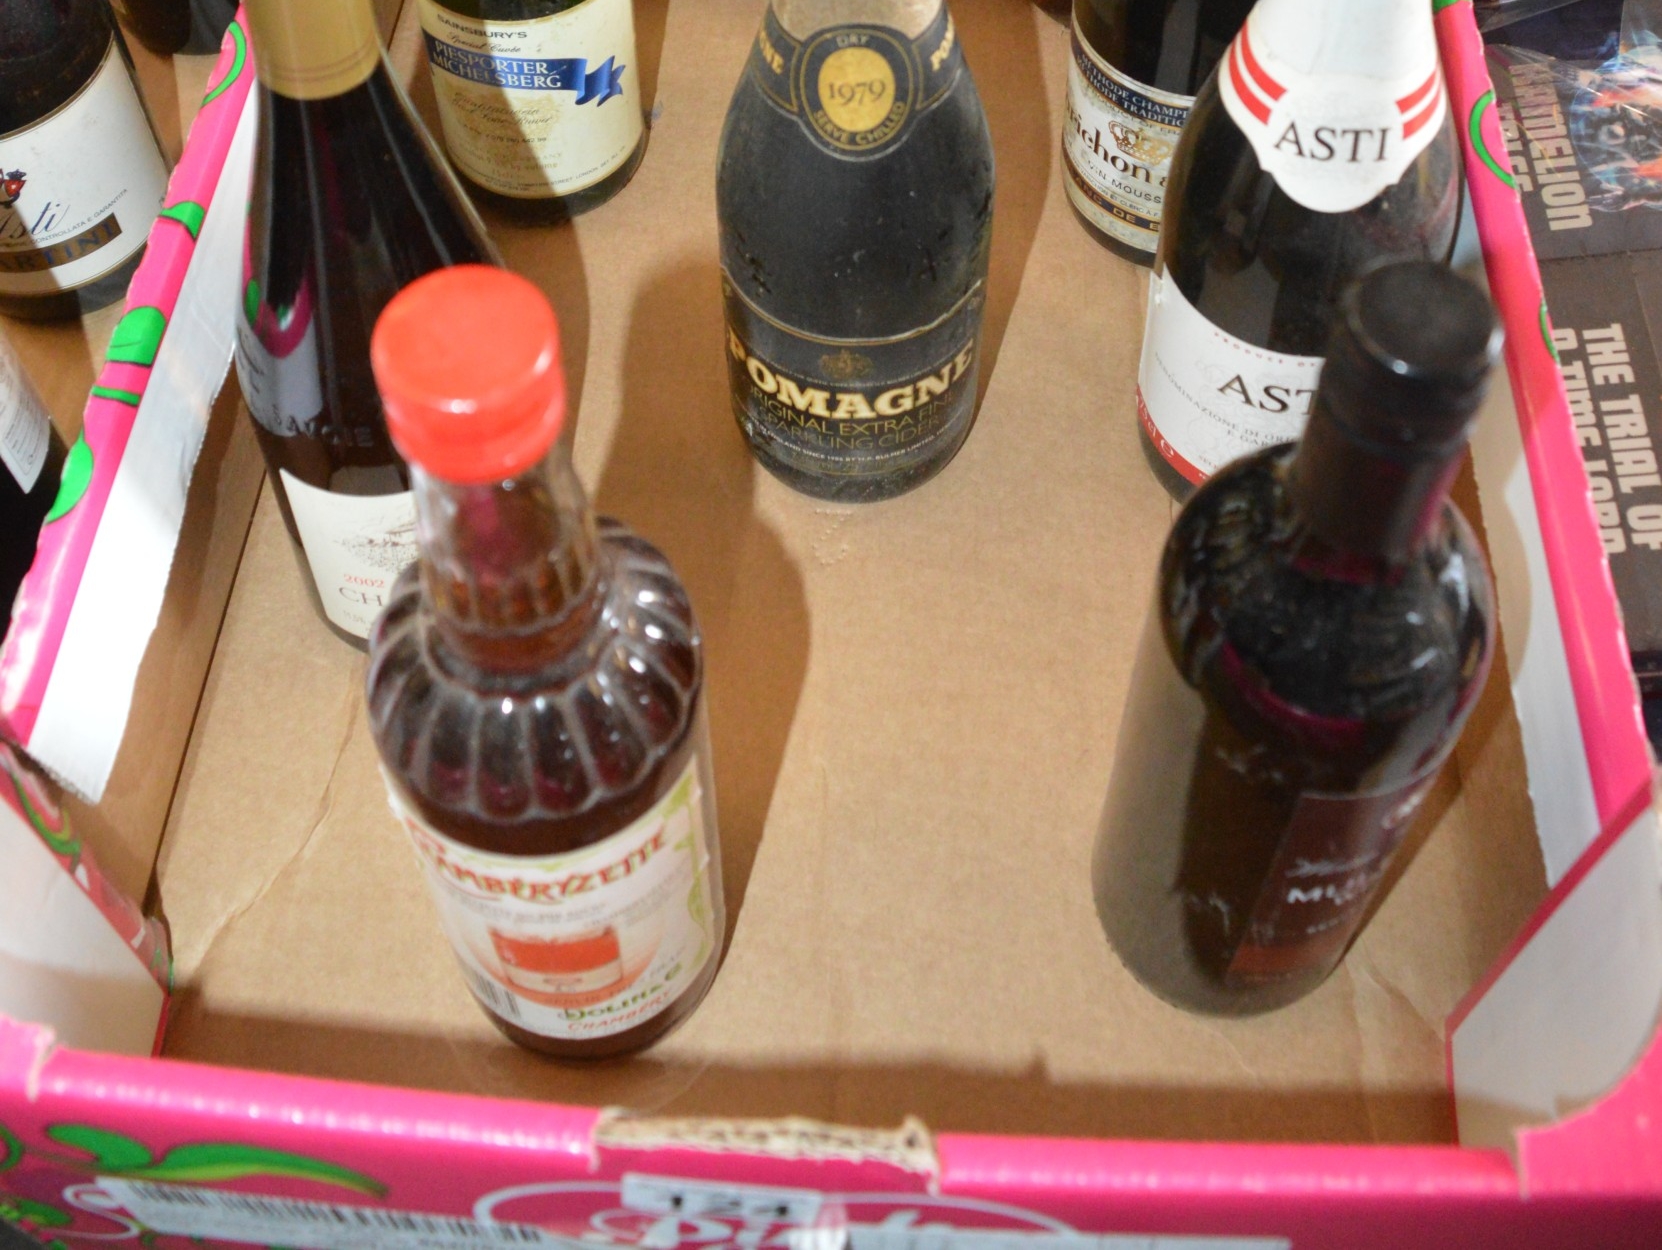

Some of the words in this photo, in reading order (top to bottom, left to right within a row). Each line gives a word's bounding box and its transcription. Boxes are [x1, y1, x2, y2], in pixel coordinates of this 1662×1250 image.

[437, 13, 527, 38] SAINSBURY'S
[432, 51, 561, 88] MICHELSBERG
[434, 40, 548, 74] PIESPORTER
[828, 80, 885, 106] 1979
[814, 110, 849, 144] SERVE
[856, 102, 907, 144] CHILLED
[1274, 121, 1391, 163] ASTI
[1509, 64, 1593, 231] KAMELION
[1111, 179, 1162, 204] MOUSS
[1582, 323, 1636, 386] THE
[839, 415, 913, 436] EXTRA
[879, 417, 939, 447] CIDER
[876, 449, 905, 460] BULMER
[1599, 393, 1662, 494] TRIAL
[344, 573, 385, 589] 2002
